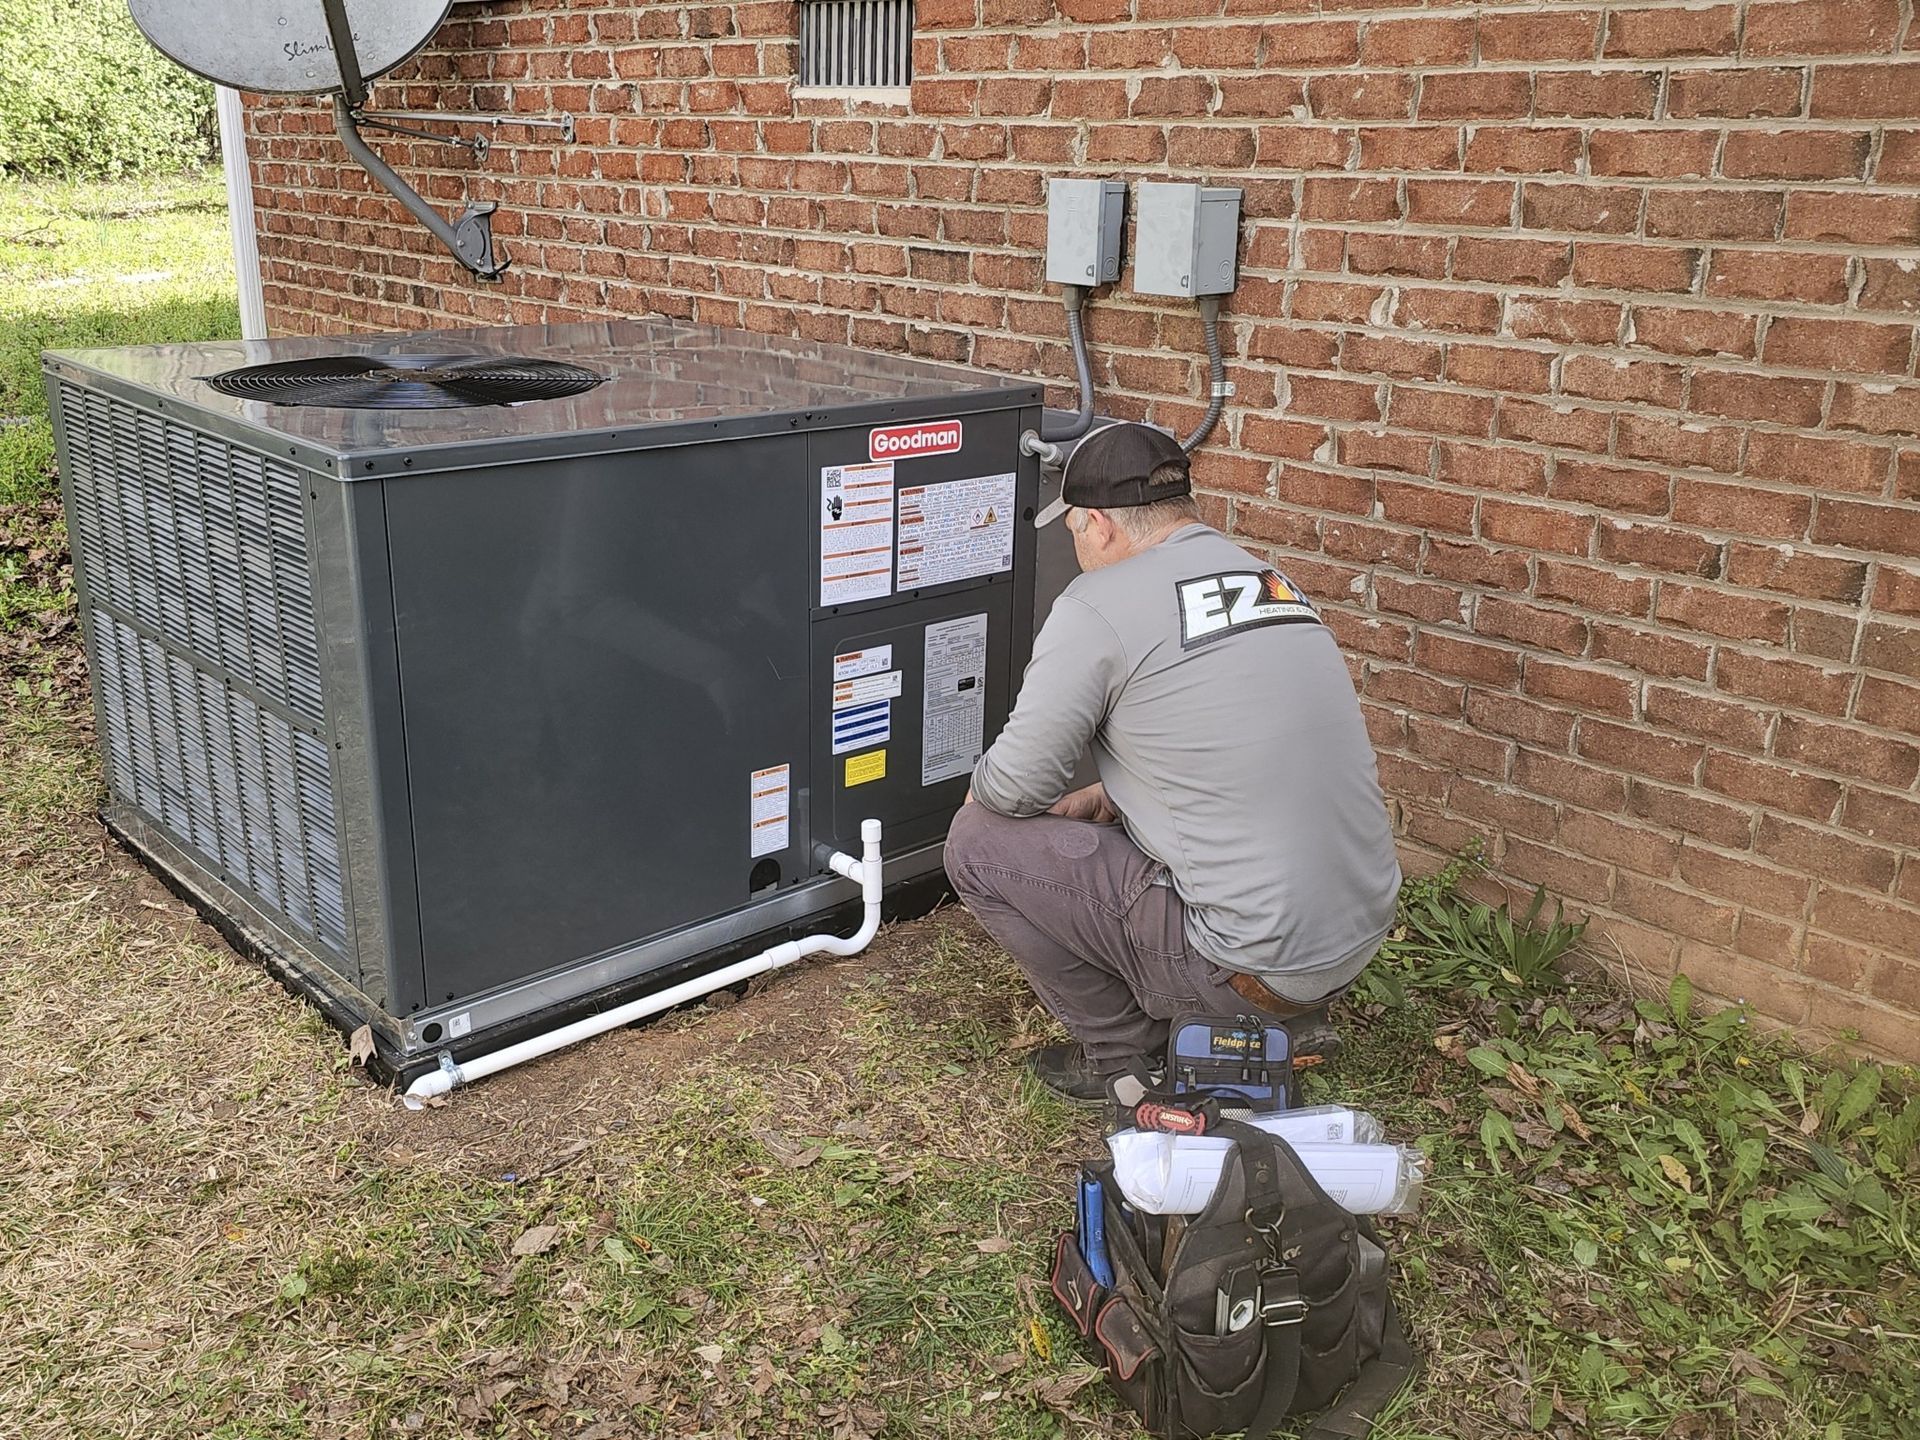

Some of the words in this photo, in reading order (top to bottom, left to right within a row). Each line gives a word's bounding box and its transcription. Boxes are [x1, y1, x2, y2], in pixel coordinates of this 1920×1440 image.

[283, 33, 361, 61] SlimLe
[874, 430, 957, 453] Goodman
[1181, 576, 1261, 640] EZ
[1260, 606, 1295, 614] HEATING
[1213, 1036, 1261, 1048] Fieldpice
[1160, 1111, 1185, 1124] HUSKY
